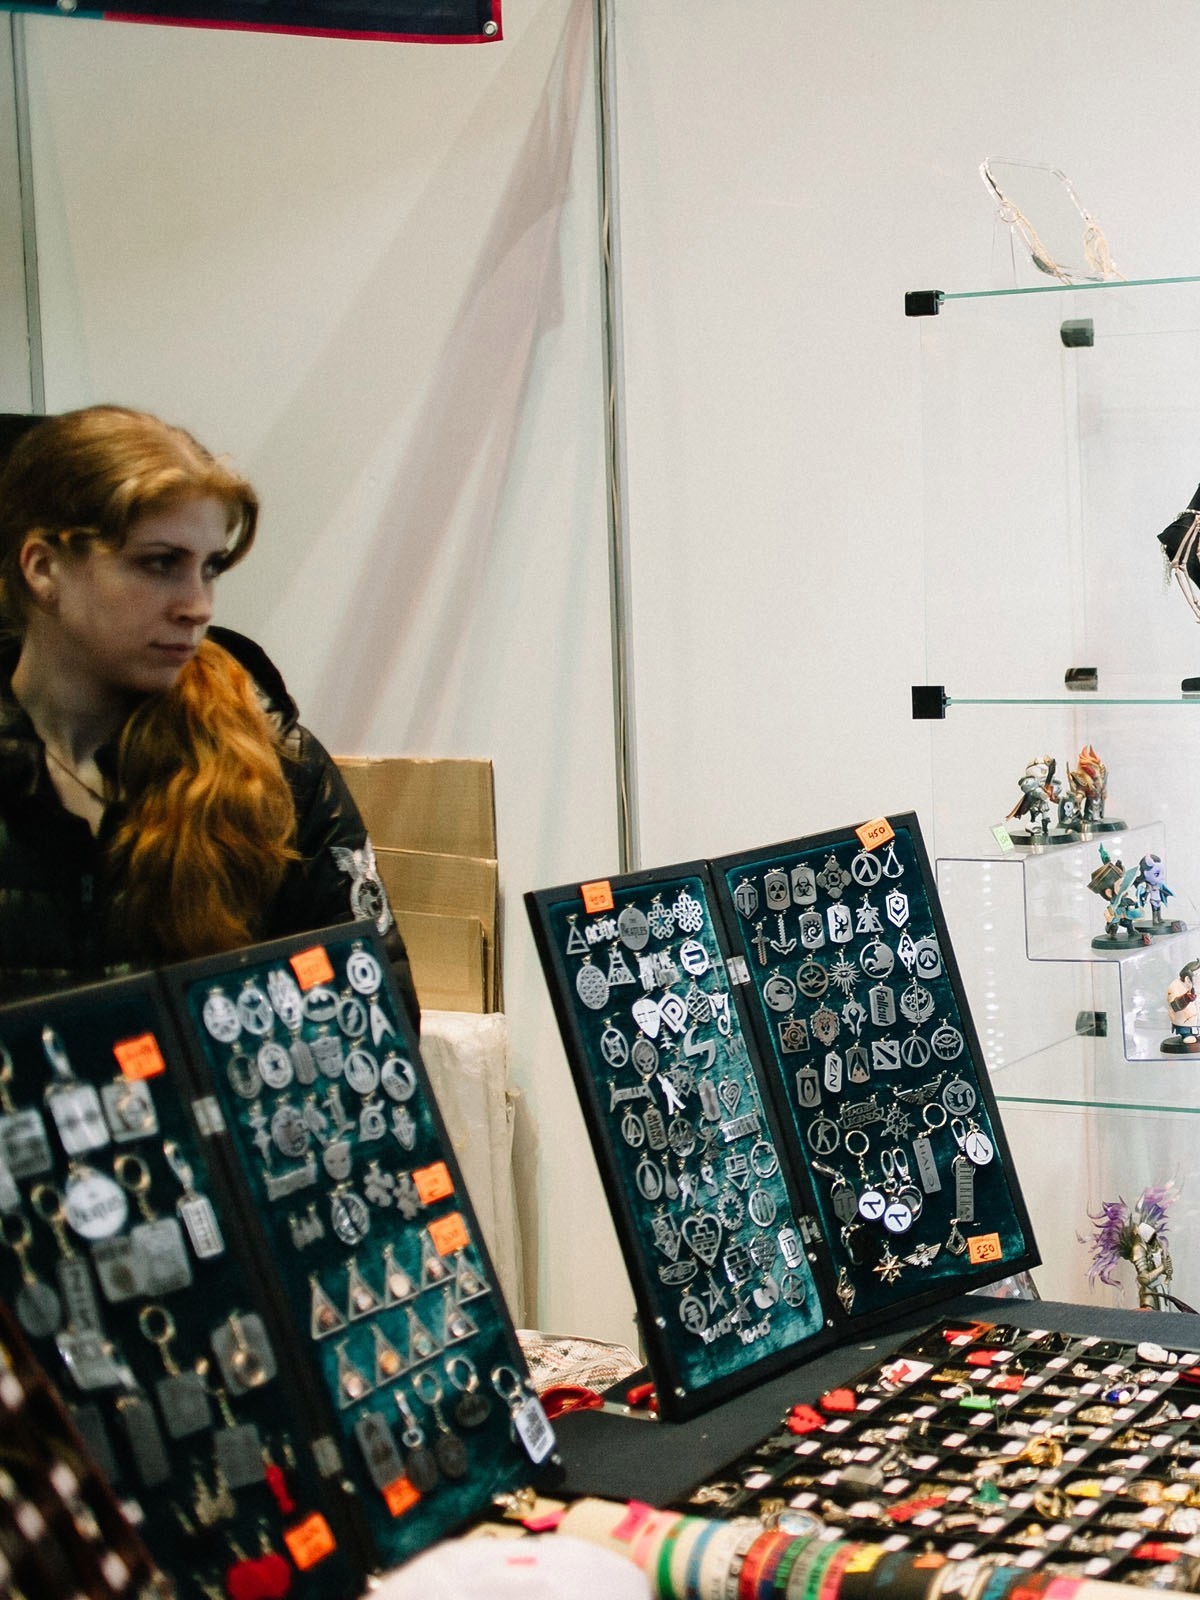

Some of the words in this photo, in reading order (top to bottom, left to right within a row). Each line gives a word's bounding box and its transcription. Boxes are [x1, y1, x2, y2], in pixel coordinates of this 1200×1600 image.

[867, 826, 886, 840] 450
[875, 989, 890, 1024] Fallout
[976, 1243, 995, 1255] 550
